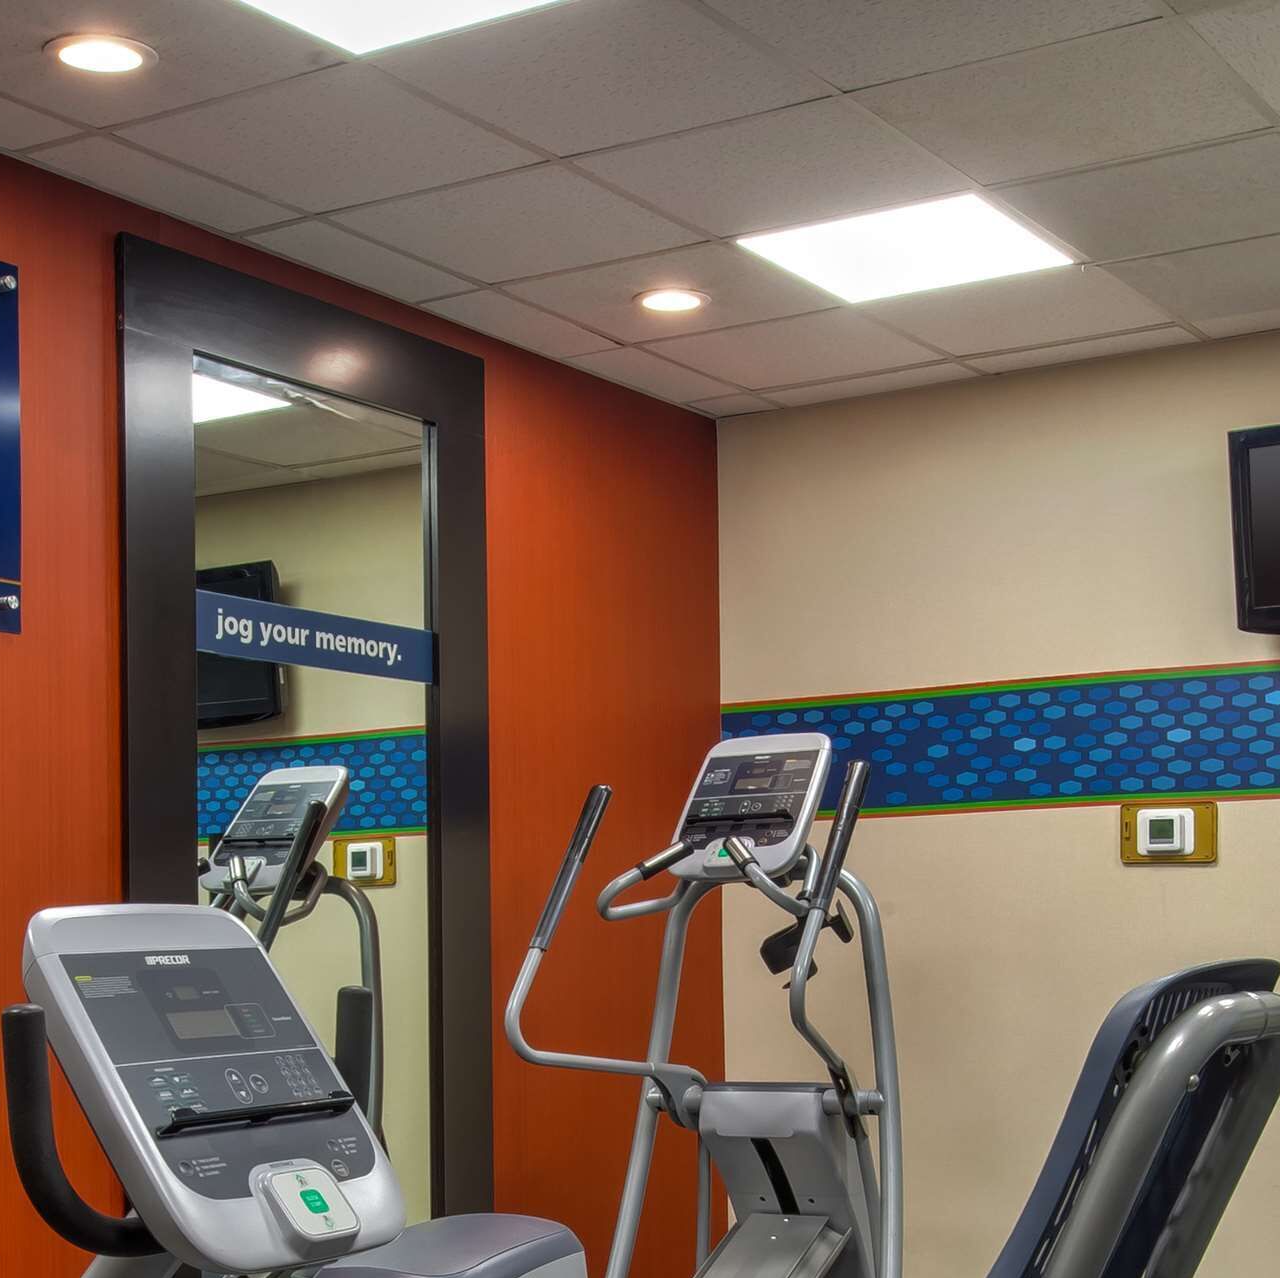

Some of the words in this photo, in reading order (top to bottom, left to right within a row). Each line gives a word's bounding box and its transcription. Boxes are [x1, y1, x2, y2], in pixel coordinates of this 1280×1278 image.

[216, 608, 252, 644] jog
[260, 622, 309, 647] your
[316, 630, 402, 666] memory.
[150, 954, 190, 966] PRECOR
